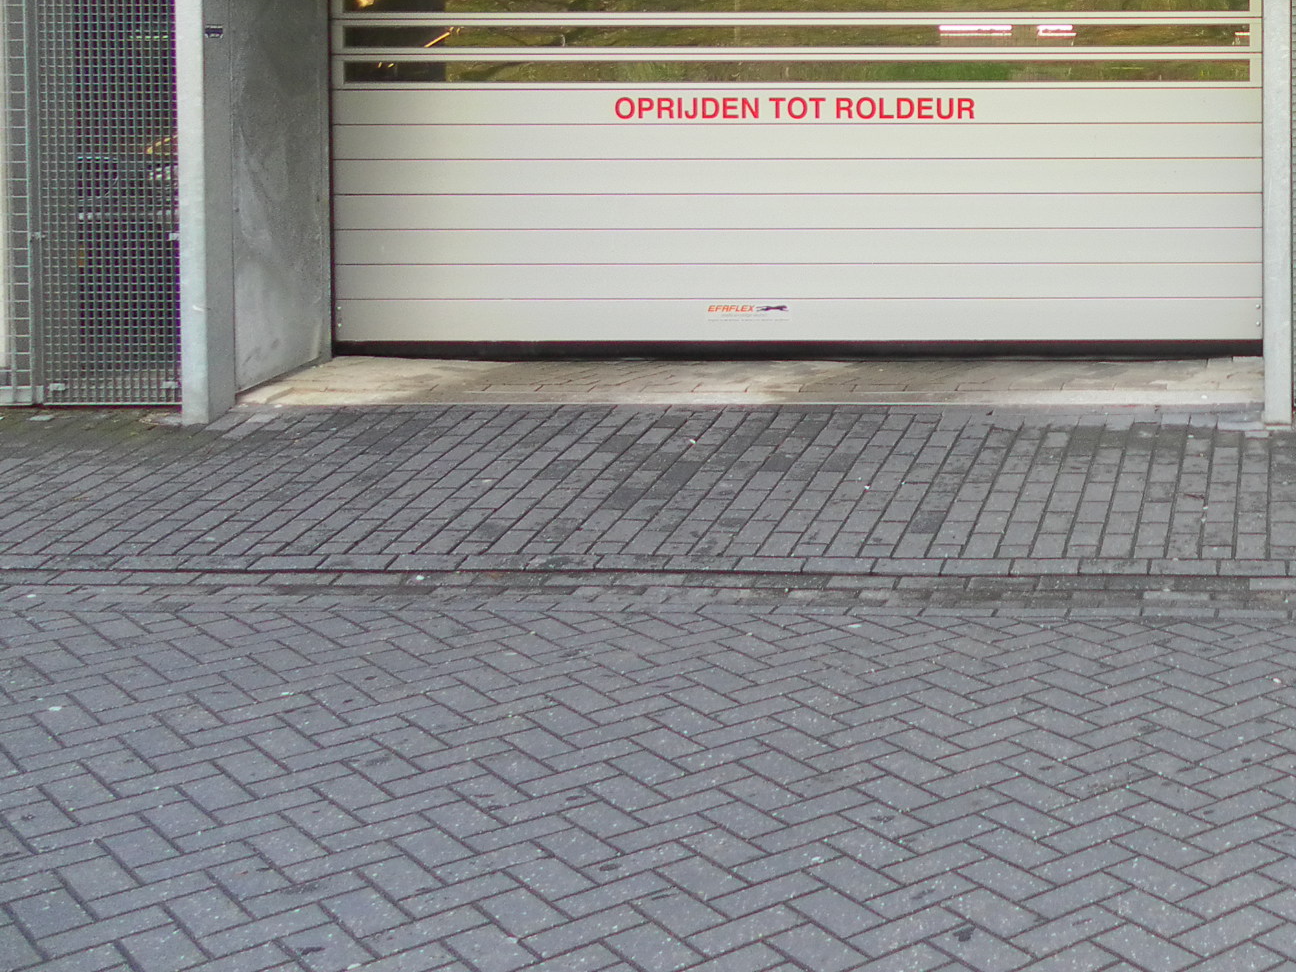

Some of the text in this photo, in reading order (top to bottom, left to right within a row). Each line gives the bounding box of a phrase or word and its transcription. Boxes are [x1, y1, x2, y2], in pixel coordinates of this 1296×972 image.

[615, 97, 976, 120] OPRIJDEN TOT ROLDEUR
[707, 304, 755, 313] EFAFLEX
